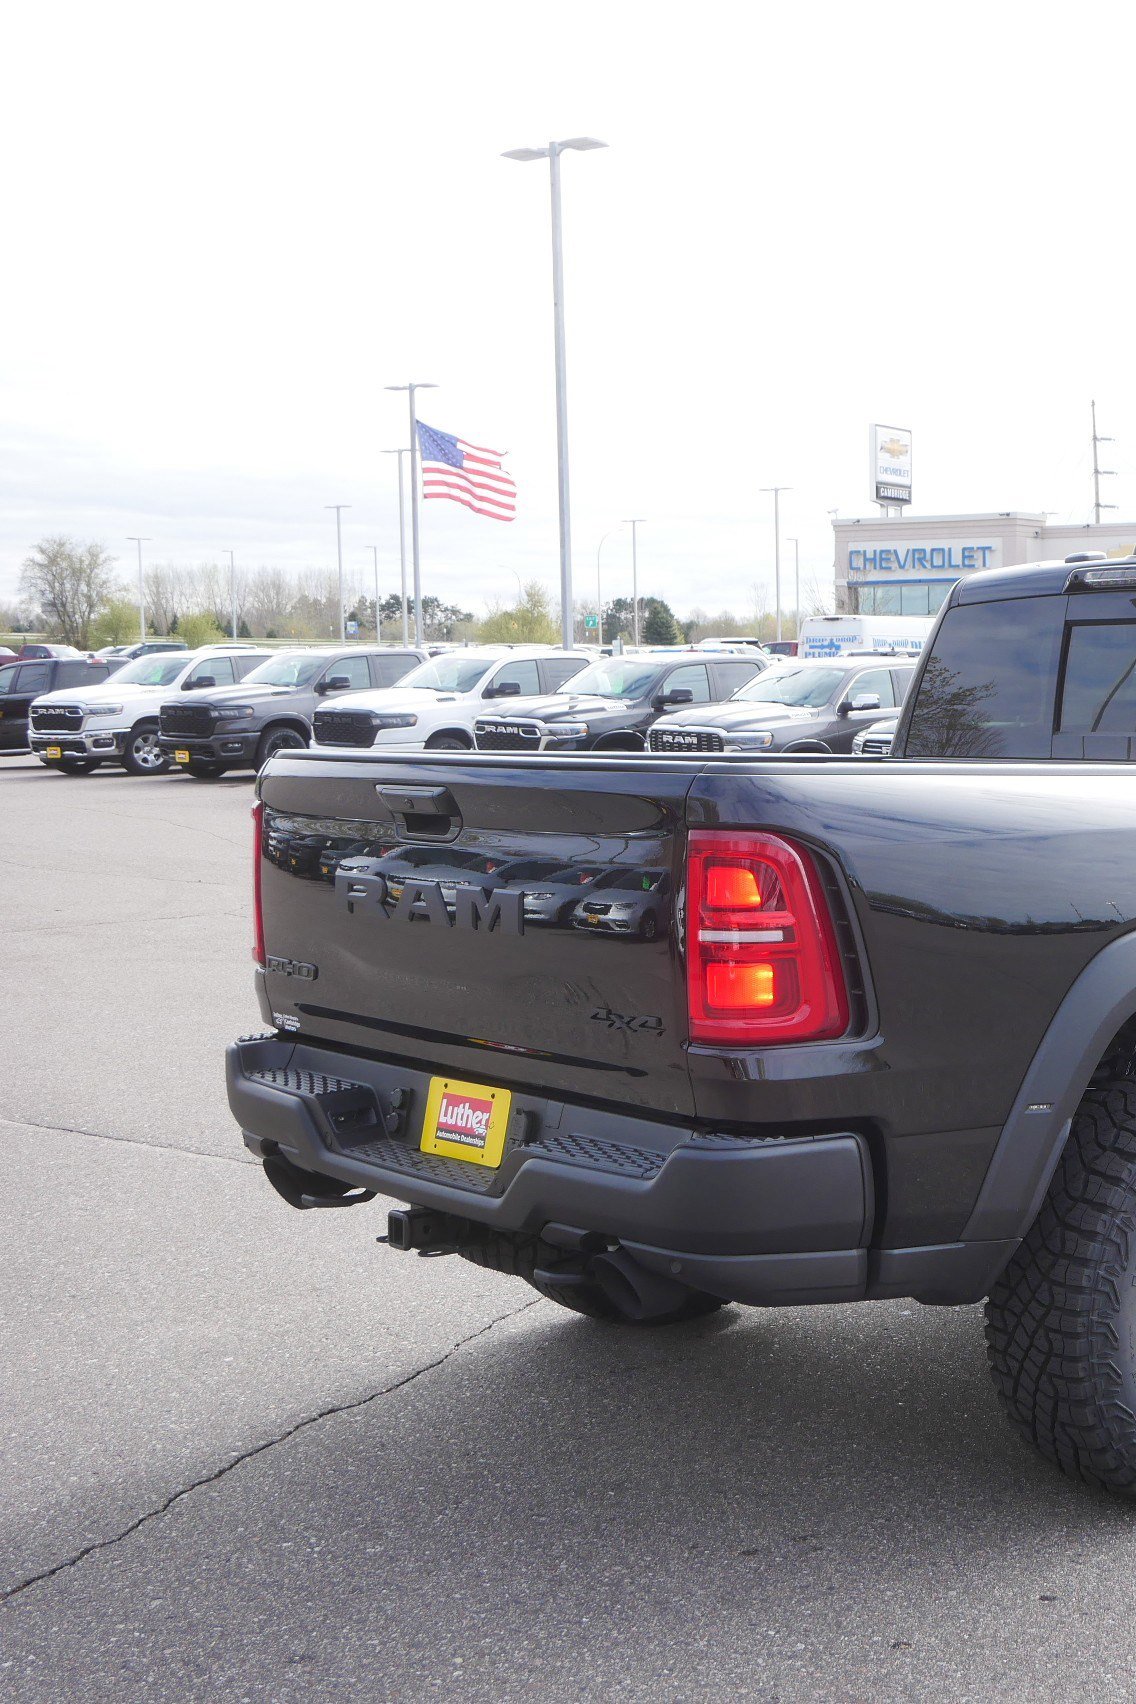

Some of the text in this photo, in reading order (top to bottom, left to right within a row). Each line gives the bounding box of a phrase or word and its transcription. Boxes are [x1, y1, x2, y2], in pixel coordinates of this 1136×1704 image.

[880, 466, 909, 477] CHEVROLET
[881, 487, 909, 499] CAMBRIDGE
[849, 546, 993, 570] CHEVROLET
[487, 725, 518, 734] RAM
[662, 734, 698, 744] RAM
[335, 872, 525, 937] RAM
[265, 954, 320, 981] RHO
[439, 1098, 490, 1129] Luther
[436, 1130, 485, 1147] Automobile Dealerships
